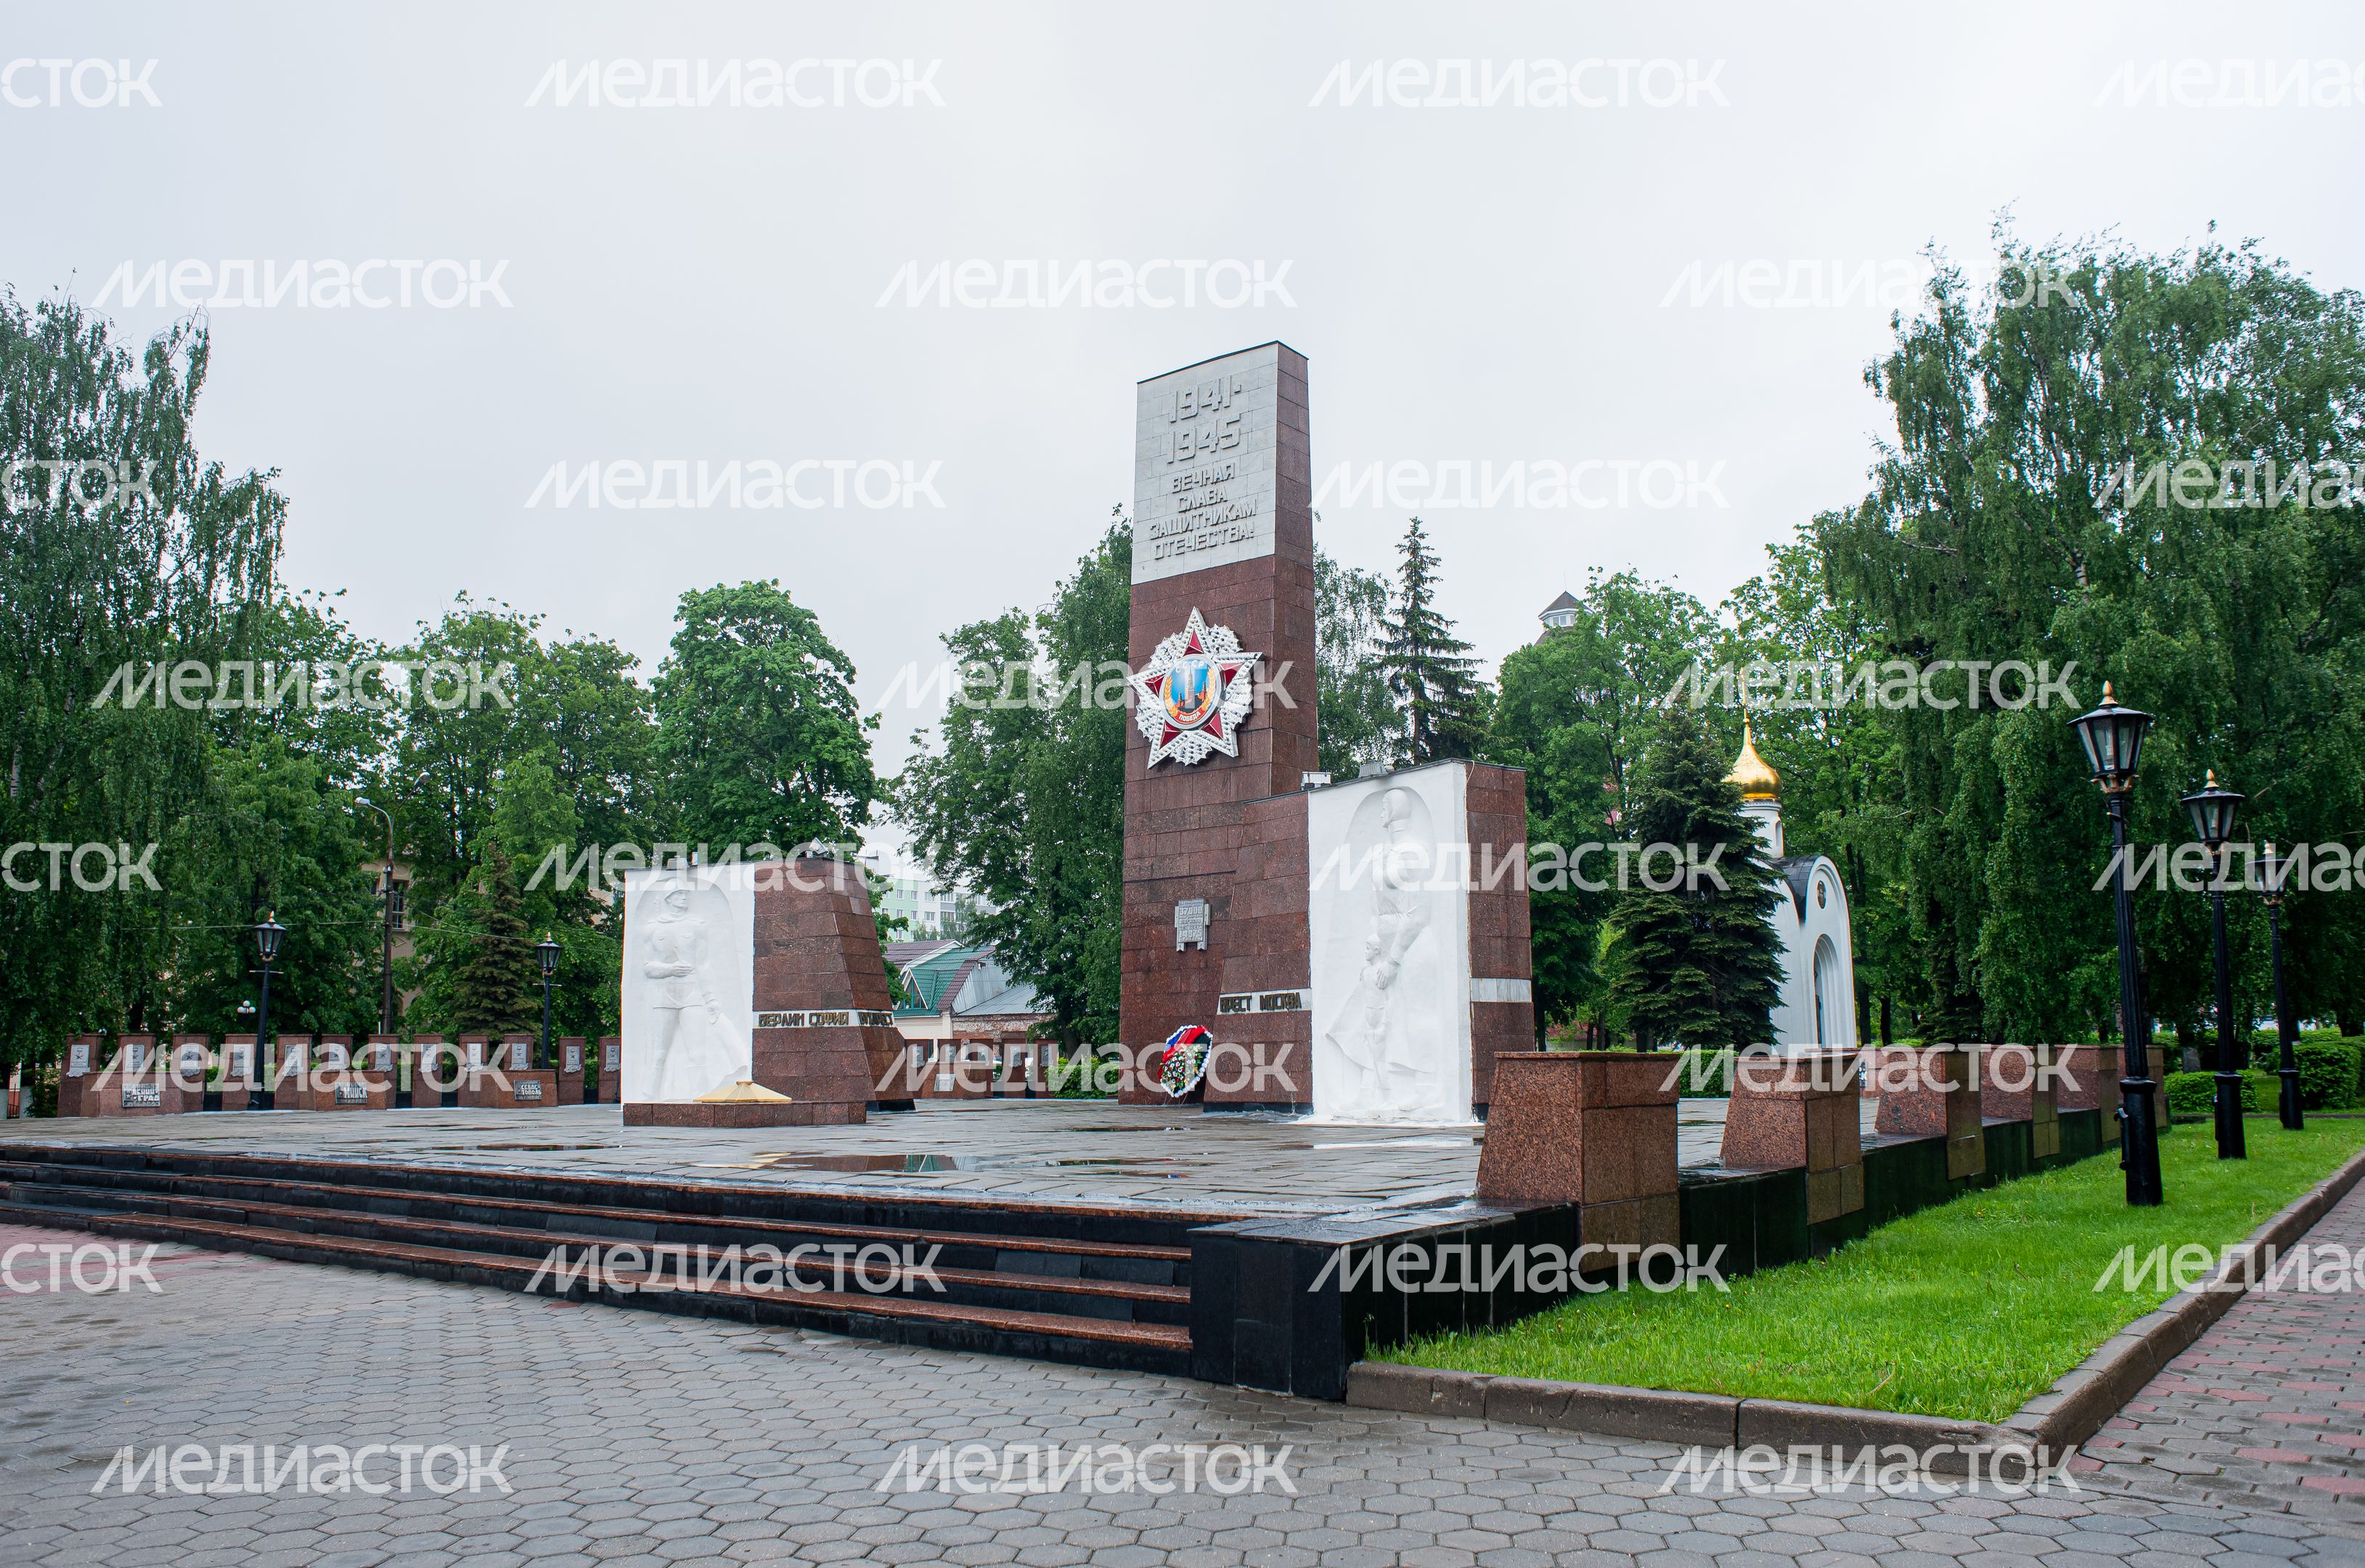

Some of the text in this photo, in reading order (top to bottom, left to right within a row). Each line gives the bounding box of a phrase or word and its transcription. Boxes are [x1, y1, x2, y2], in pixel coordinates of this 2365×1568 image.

[1167, 413, 1241, 465] 1945
[1172, 462, 1235, 494] ВЕЧНАЯ
[1179, 485, 1228, 513] СЛАВА
[1151, 499, 1257, 540] ЗАЩИТНИКАМ
[1154, 521, 1254, 560] ОТЕЧЕСТВА!
[1175, 660, 1204, 673] СССР
[1178, 711, 1201, 722] ПОБЕДА
[1220, 992, 1302, 1013] БРЕСТ МОСКВА
[758, 1011, 849, 1027] БЕРЛИН СОФИЯ
